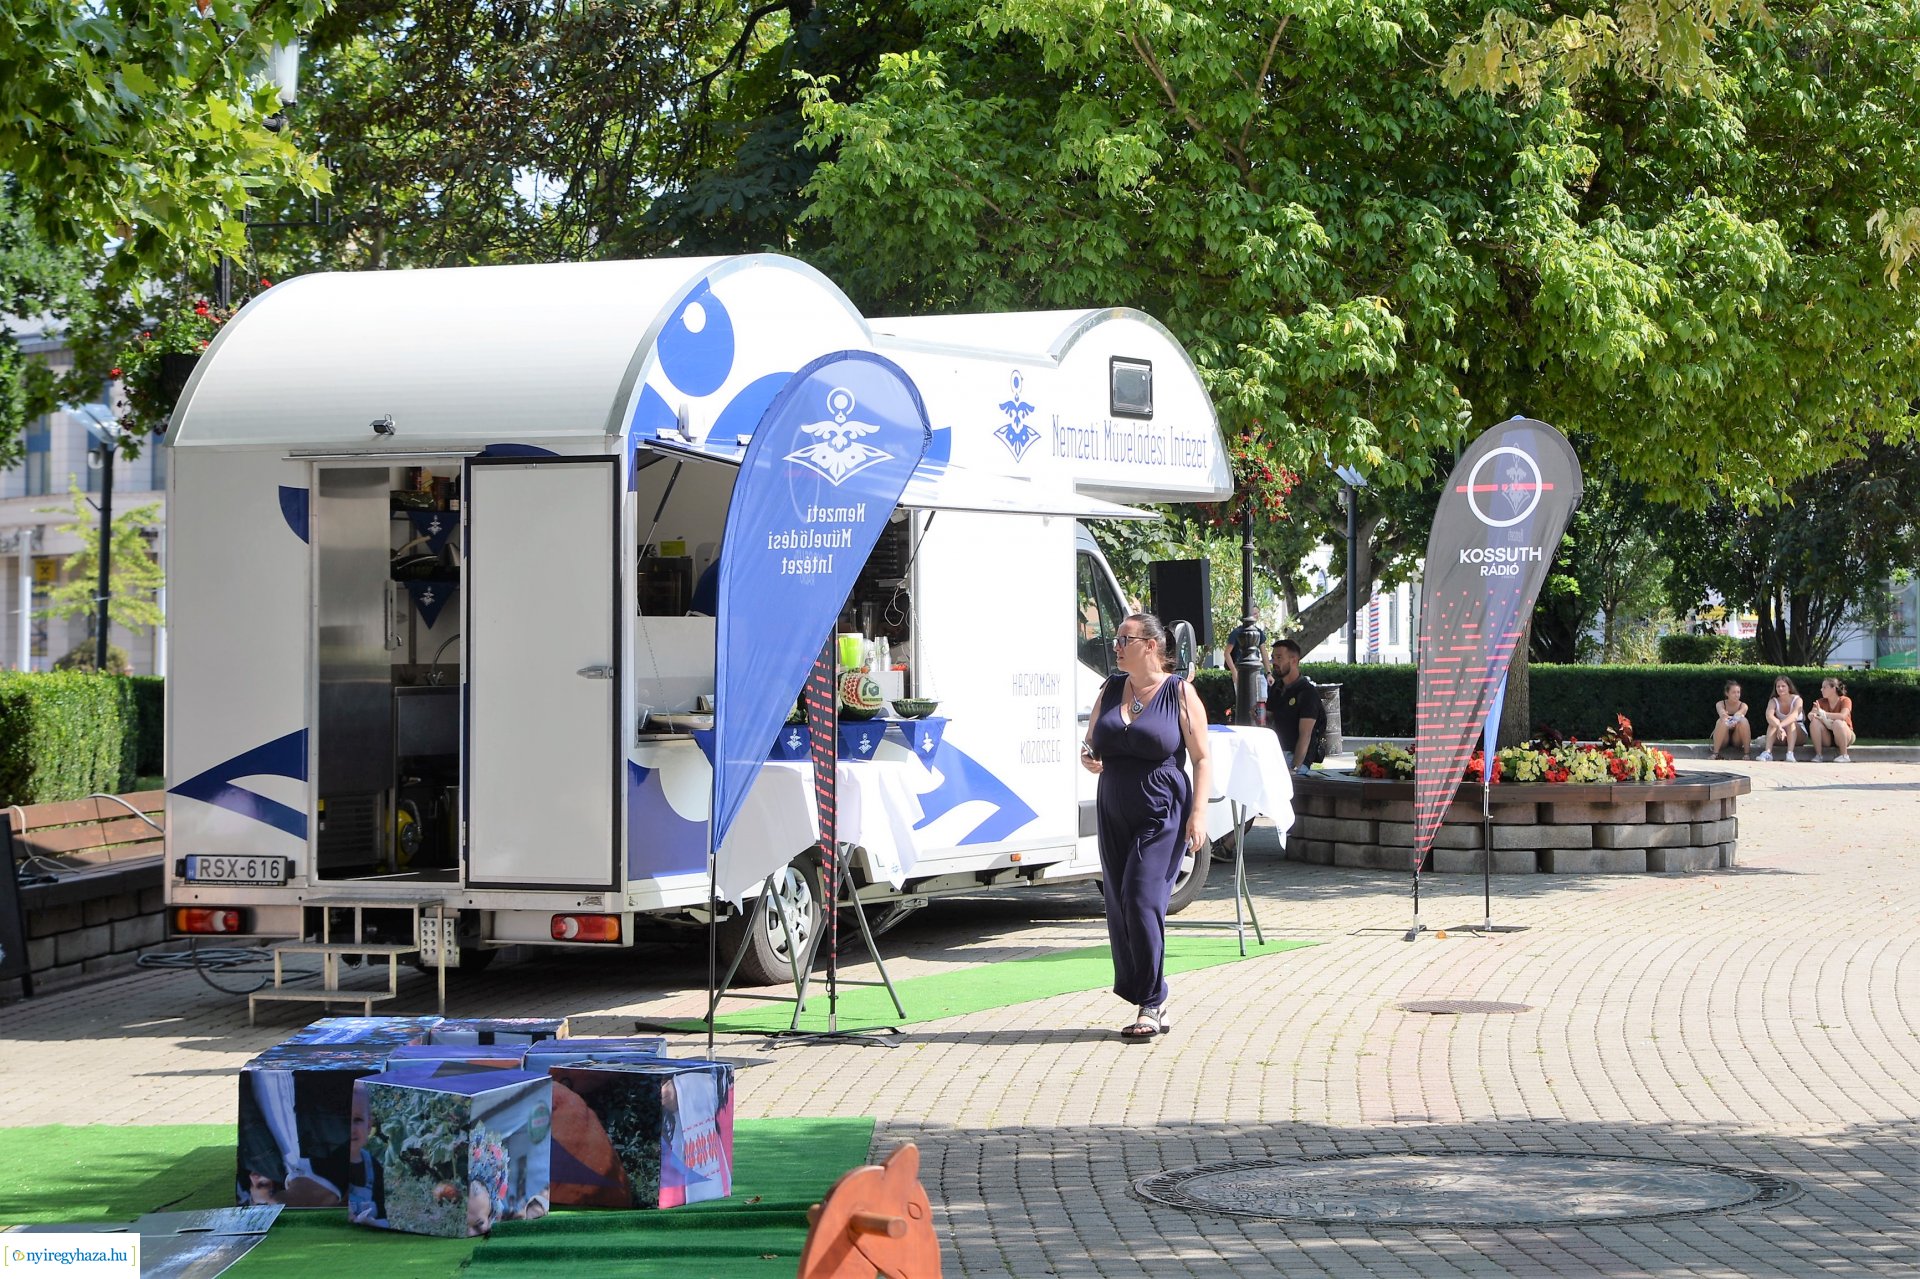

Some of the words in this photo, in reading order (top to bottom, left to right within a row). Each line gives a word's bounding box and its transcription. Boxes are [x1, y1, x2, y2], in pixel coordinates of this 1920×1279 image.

[1052, 414, 1099, 461] Nemzeti
[1104, 419, 1166, 466] Művelődési
[1170, 425, 1207, 469] Intézet
[1459, 547, 1542, 564] KOSSUTH
[1480, 562, 1519, 577] RÁDIÓ
[199, 858, 280, 879] RSX-616
